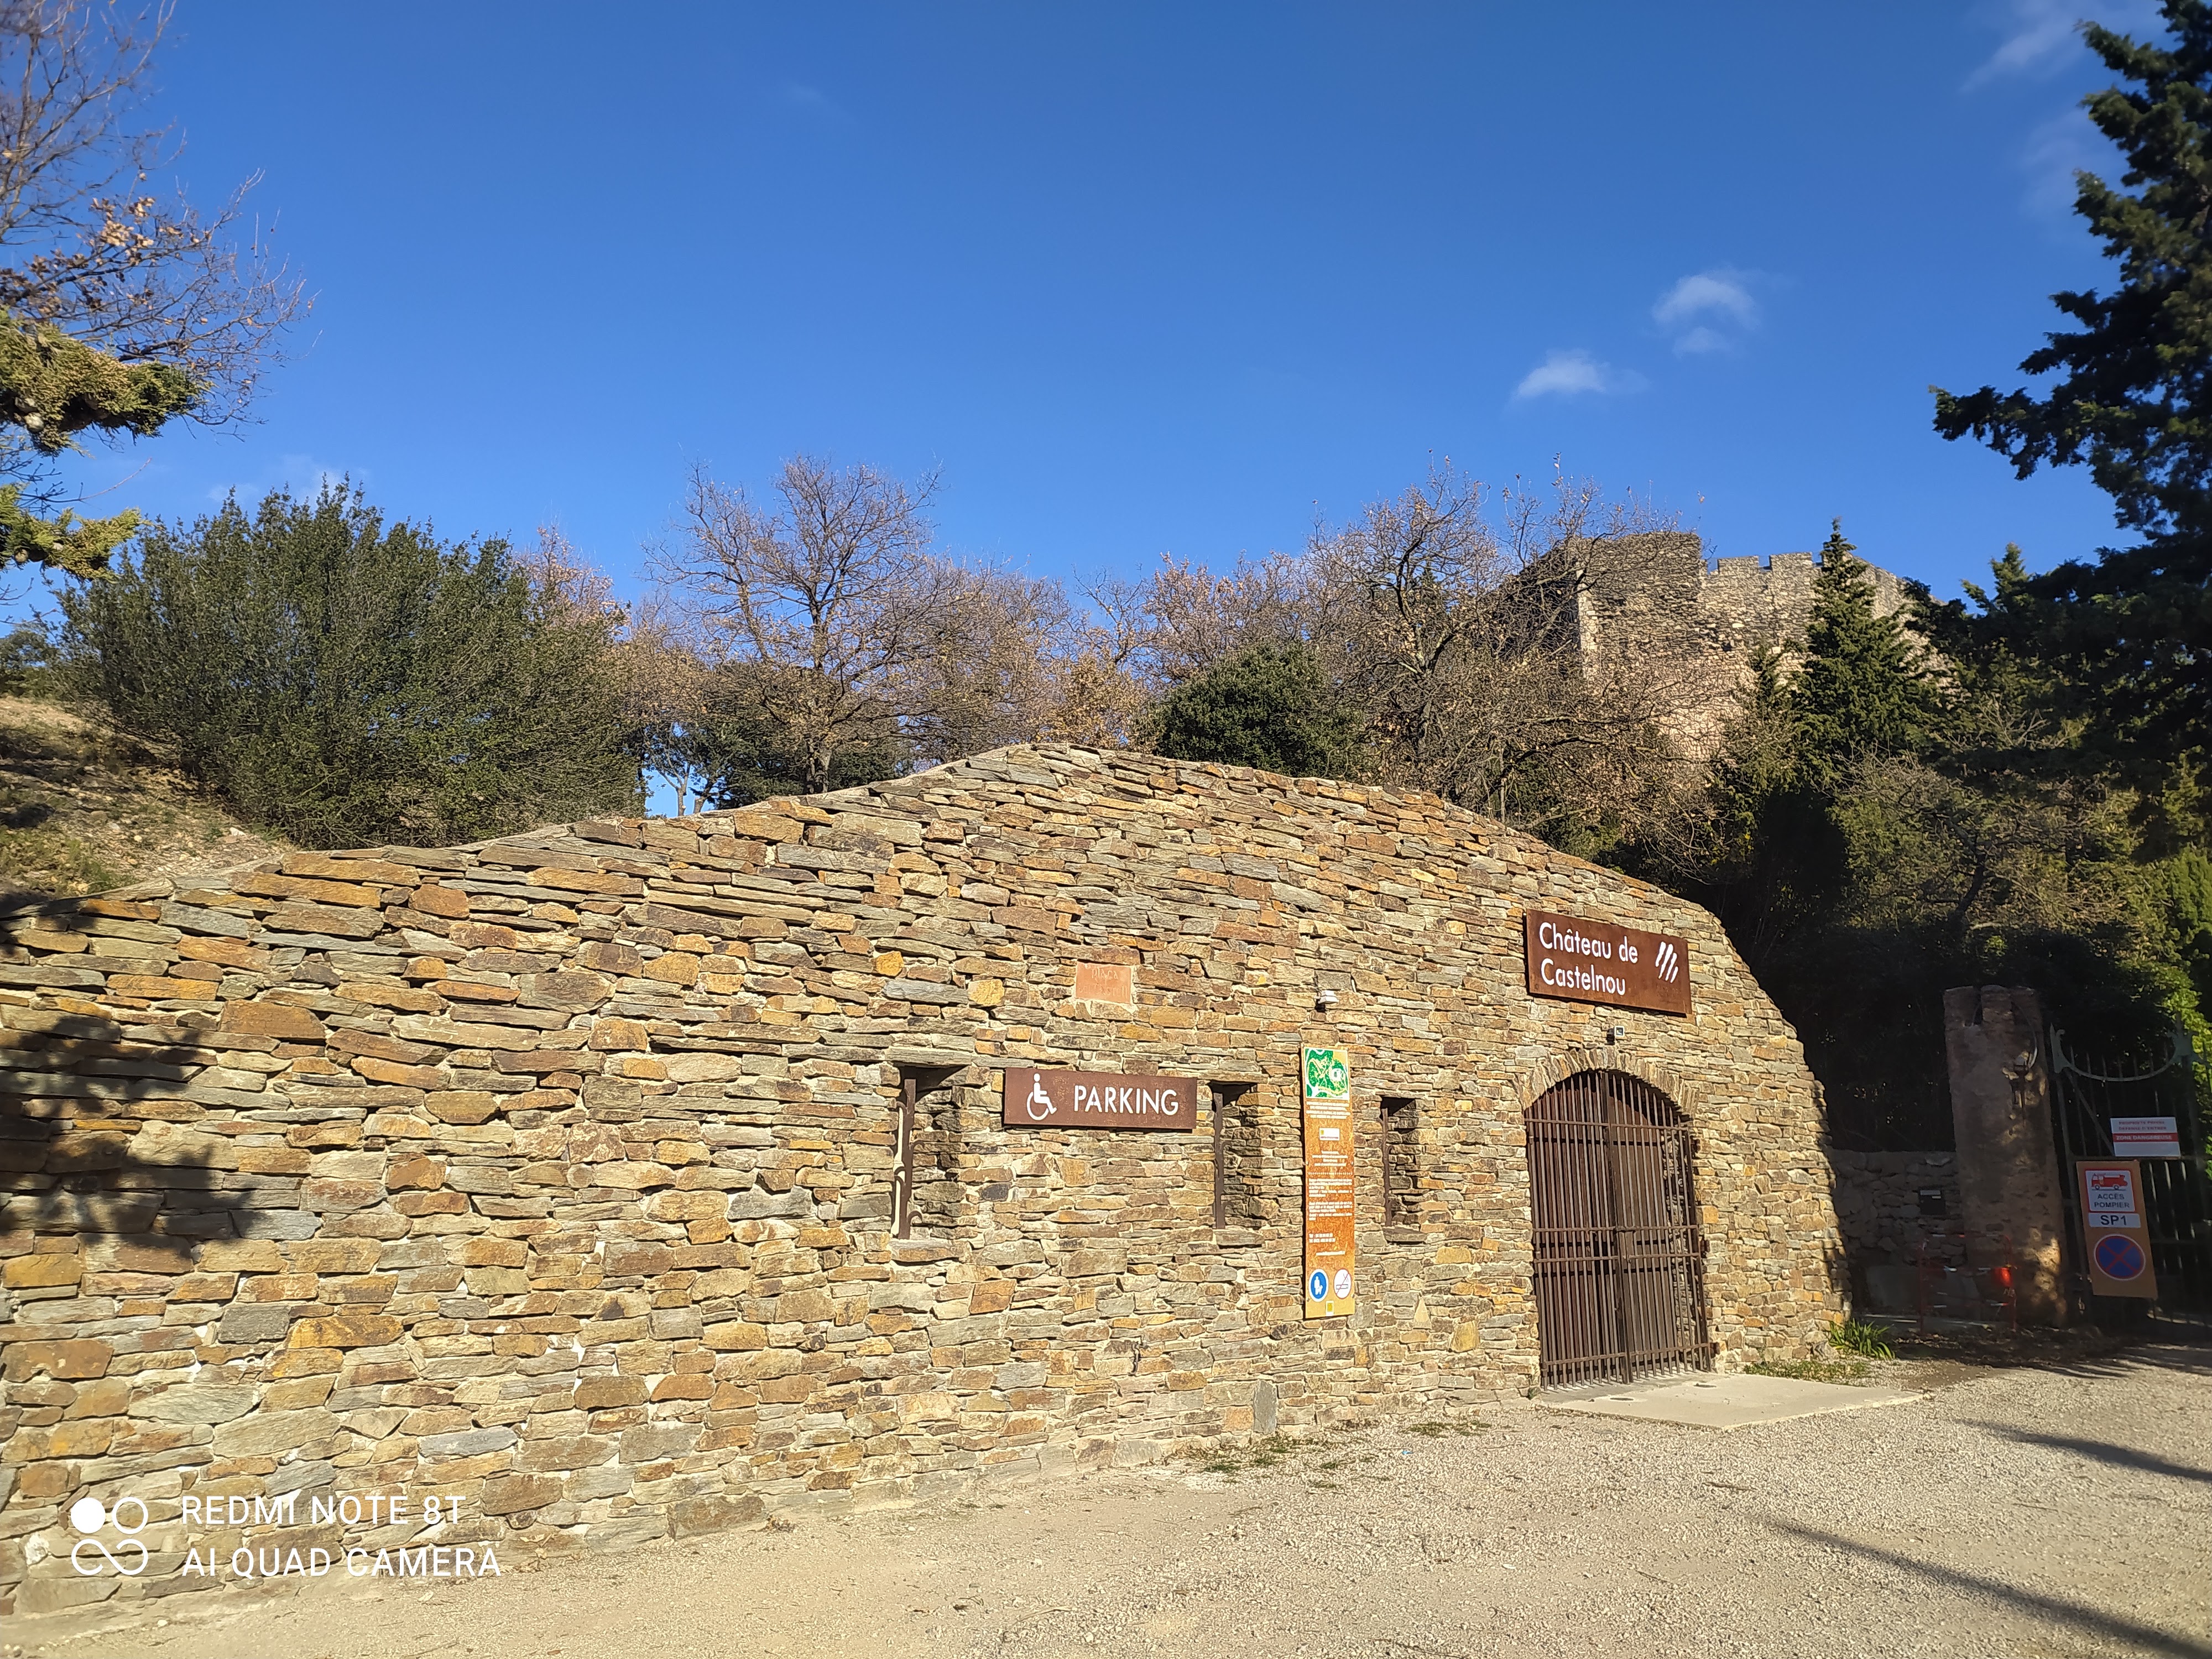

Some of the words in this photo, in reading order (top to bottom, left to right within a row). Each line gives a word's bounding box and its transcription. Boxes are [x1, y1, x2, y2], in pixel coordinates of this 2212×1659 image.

[1539, 922, 1612, 959] Château
[1619, 936, 1639, 963] de
[1541, 958, 1626, 995] Castelnou
[1074, 1085, 1179, 1116] PARKING
[2100, 1214, 2127, 1225] SP1
